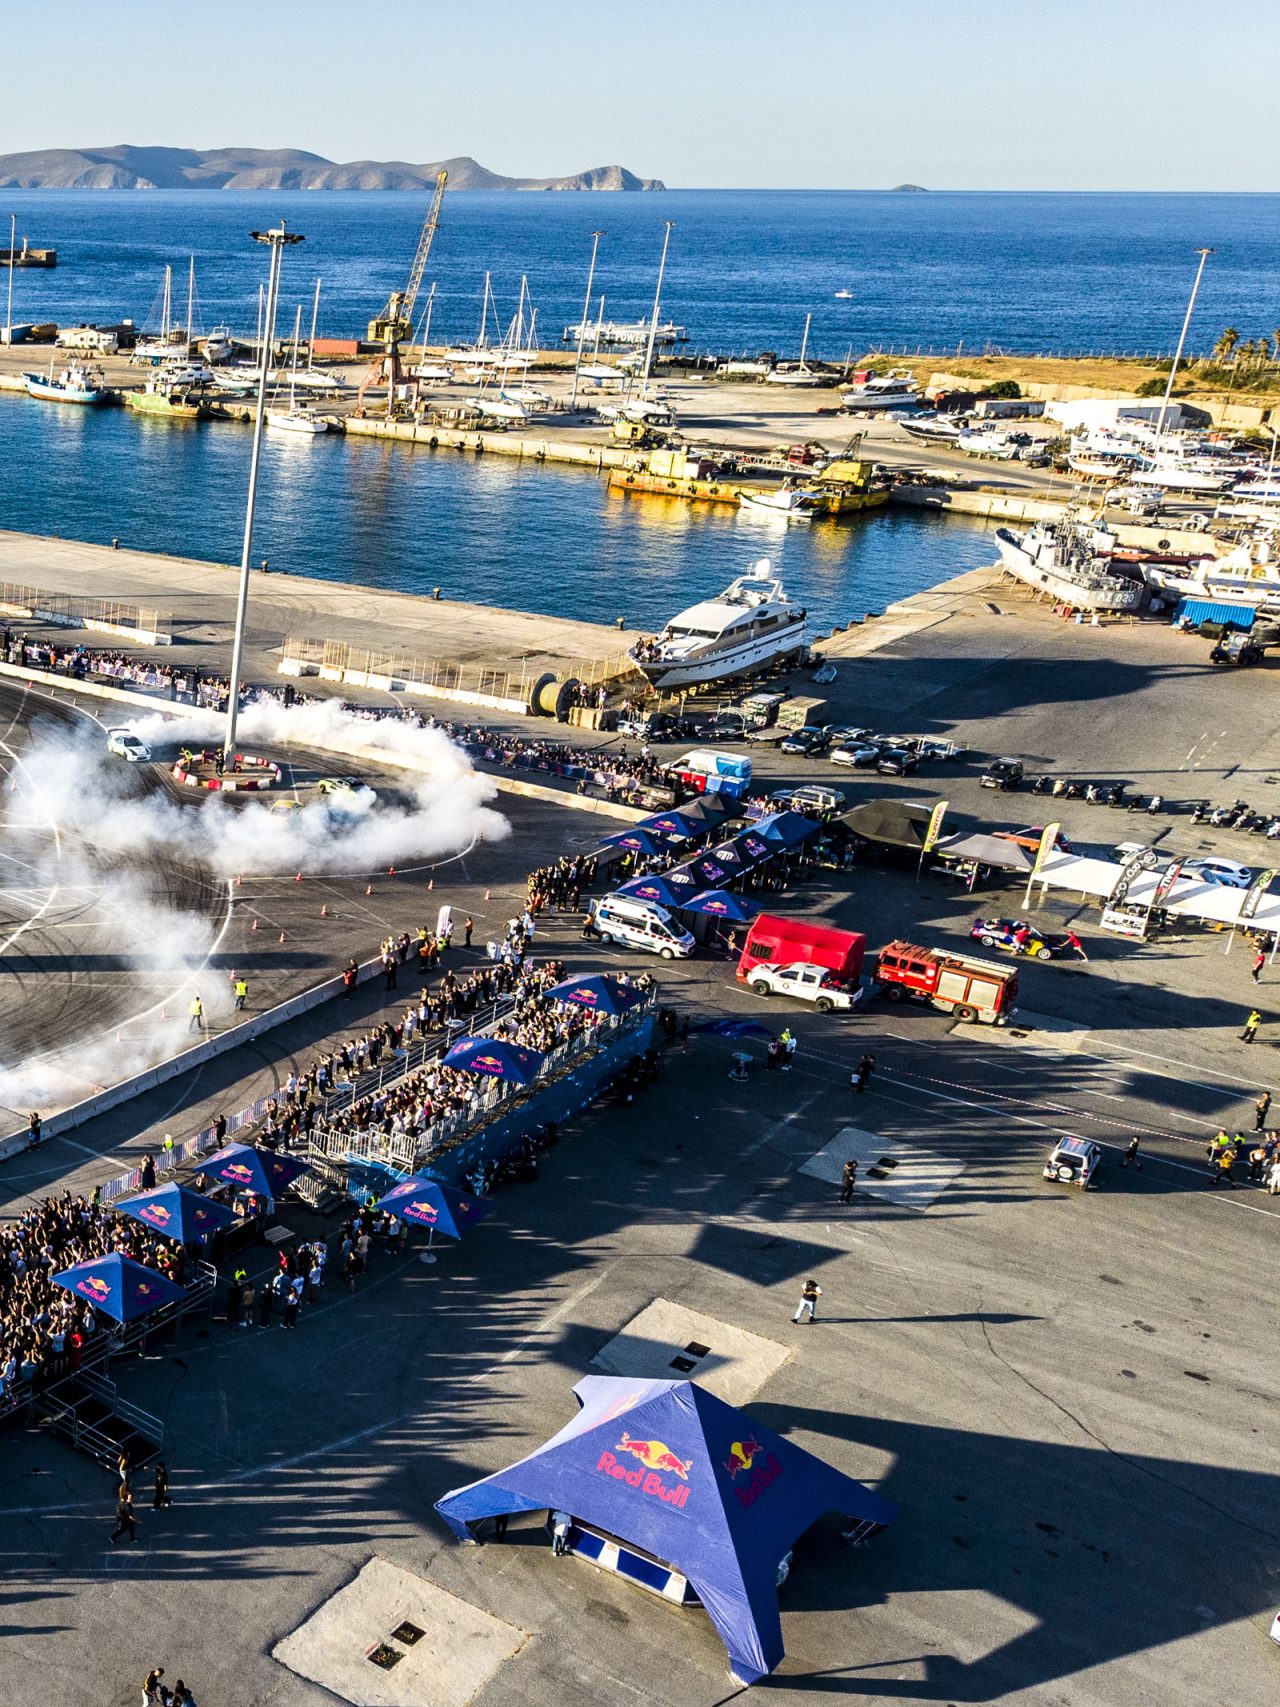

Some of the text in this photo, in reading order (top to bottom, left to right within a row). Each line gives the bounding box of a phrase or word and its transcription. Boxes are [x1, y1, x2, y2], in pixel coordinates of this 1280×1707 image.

[470, 1061, 503, 1073] Red Bull
[221, 1169, 252, 1183] Red Bull
[139, 1208, 167, 1227] Red Bull
[404, 1206, 436, 1223] Red Bull
[77, 1281, 107, 1302] Red Bull
[597, 1451, 691, 1508] Red Bull
